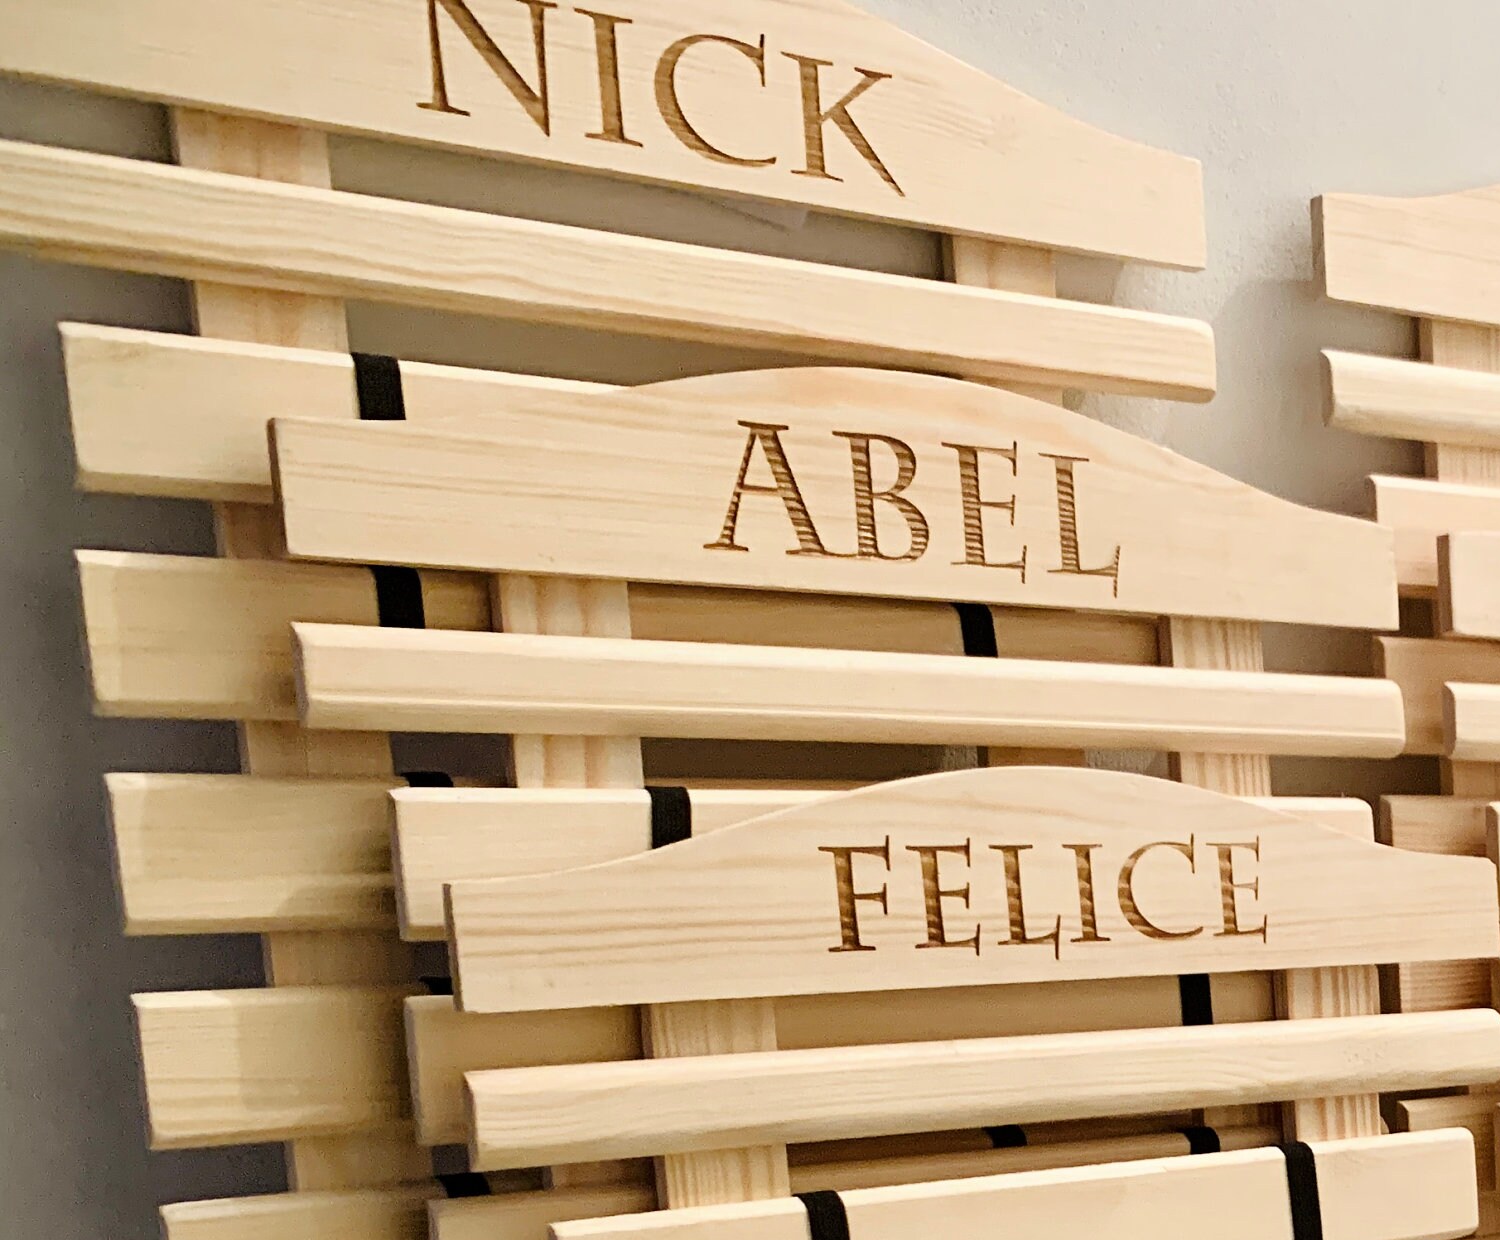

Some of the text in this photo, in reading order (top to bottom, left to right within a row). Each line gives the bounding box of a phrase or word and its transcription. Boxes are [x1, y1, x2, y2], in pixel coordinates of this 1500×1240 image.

[416, 0, 906, 197] NICK
[702, 420, 1121, 598] ABEL
[817, 832, 1268, 960] FELICE
